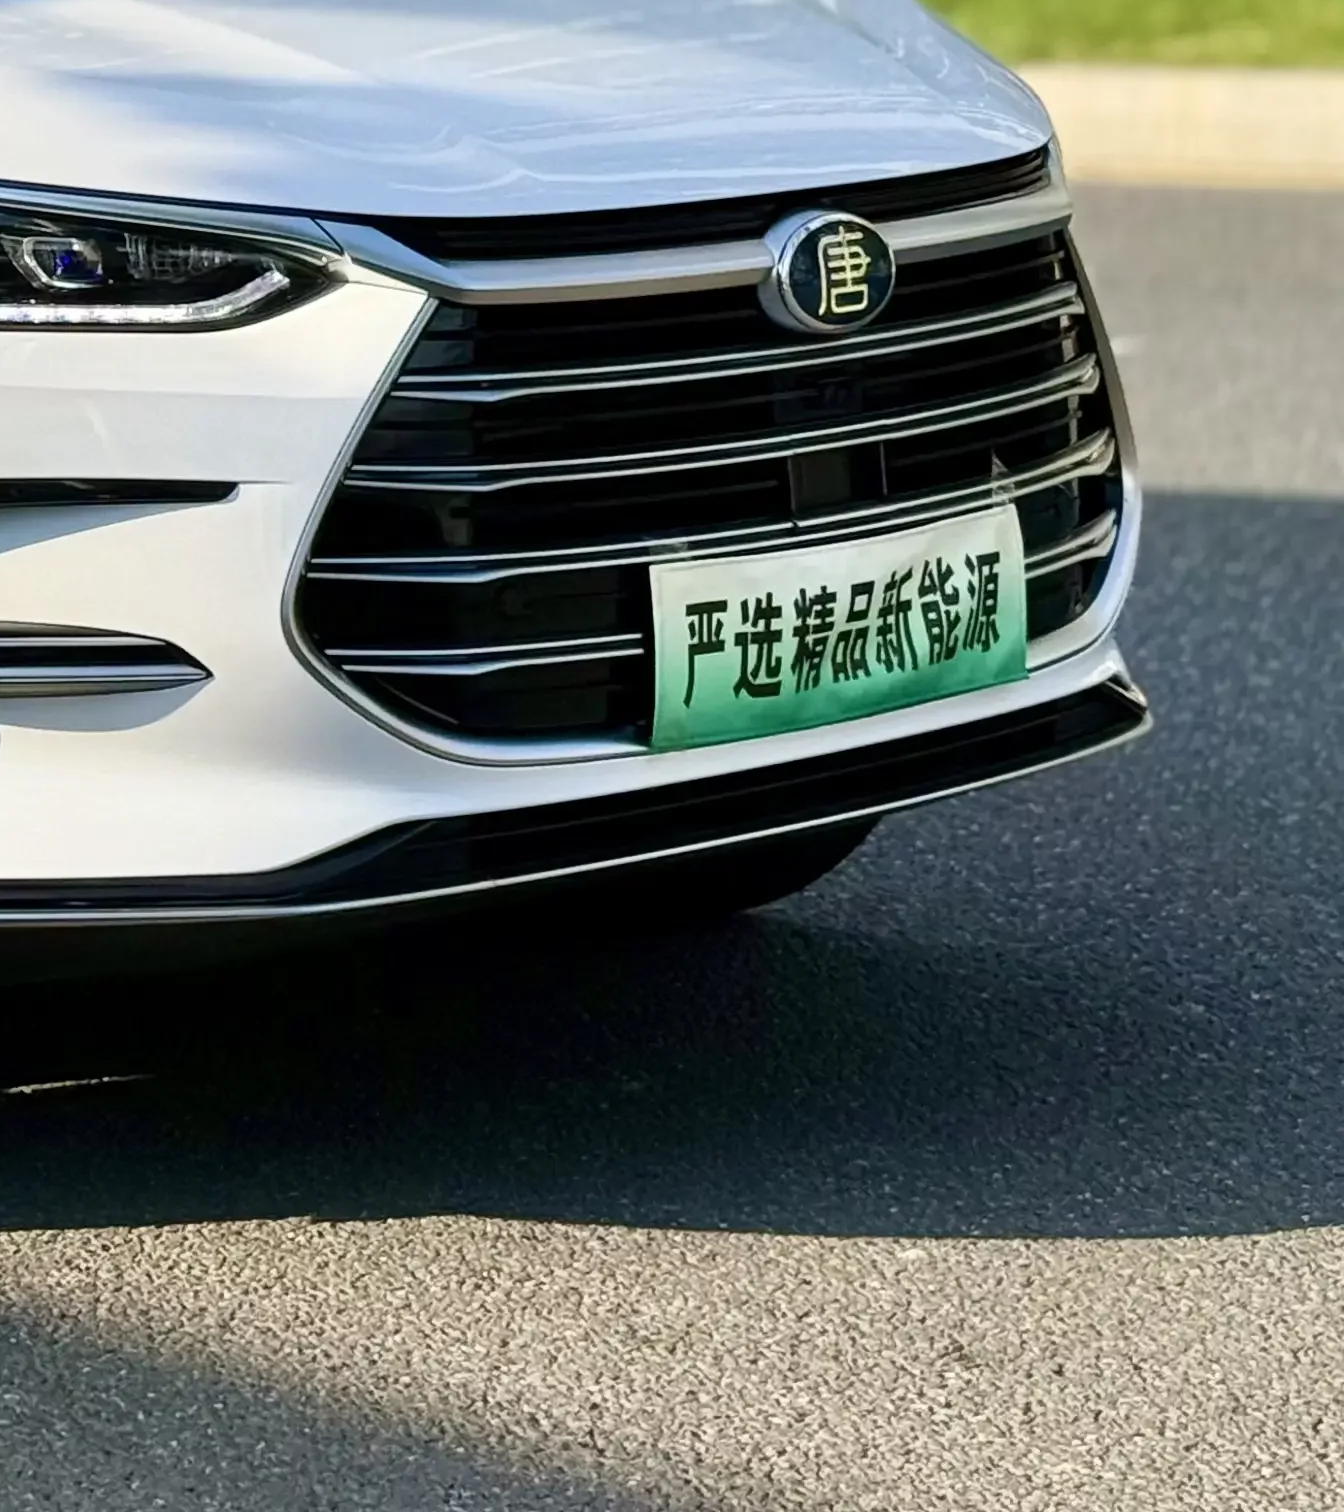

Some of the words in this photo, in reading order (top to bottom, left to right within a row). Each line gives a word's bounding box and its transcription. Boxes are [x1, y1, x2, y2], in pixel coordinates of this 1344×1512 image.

[818, 225, 872, 317] 唐
[683, 550, 1001, 709] 严选精品新能源
